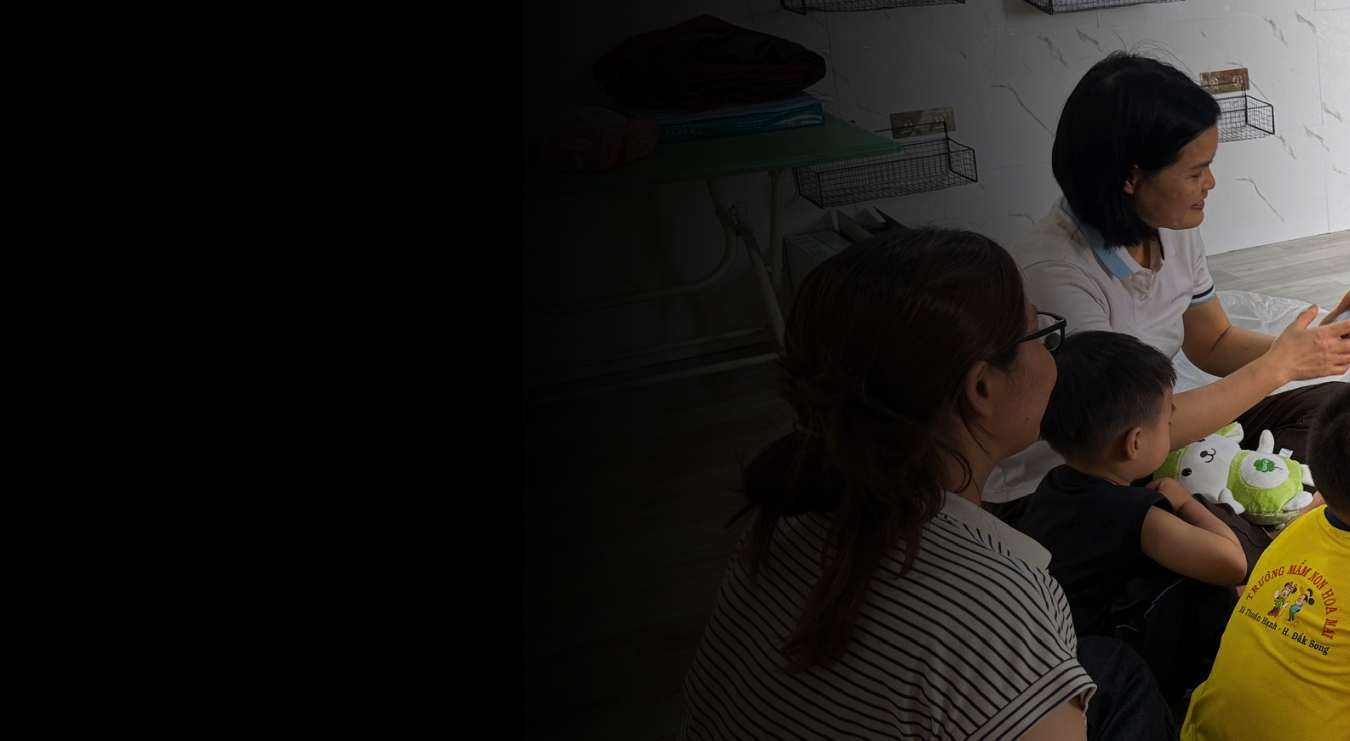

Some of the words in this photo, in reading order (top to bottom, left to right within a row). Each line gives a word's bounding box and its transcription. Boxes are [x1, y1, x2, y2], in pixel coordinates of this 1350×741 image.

[1308, 571, 1329, 590] NON
[1321, 588, 1338, 615] HOA
[1321, 618, 1338, 640] MAI
[1281, 627, 1290, 637] H.
[1308, 639, 1330, 656] Song
